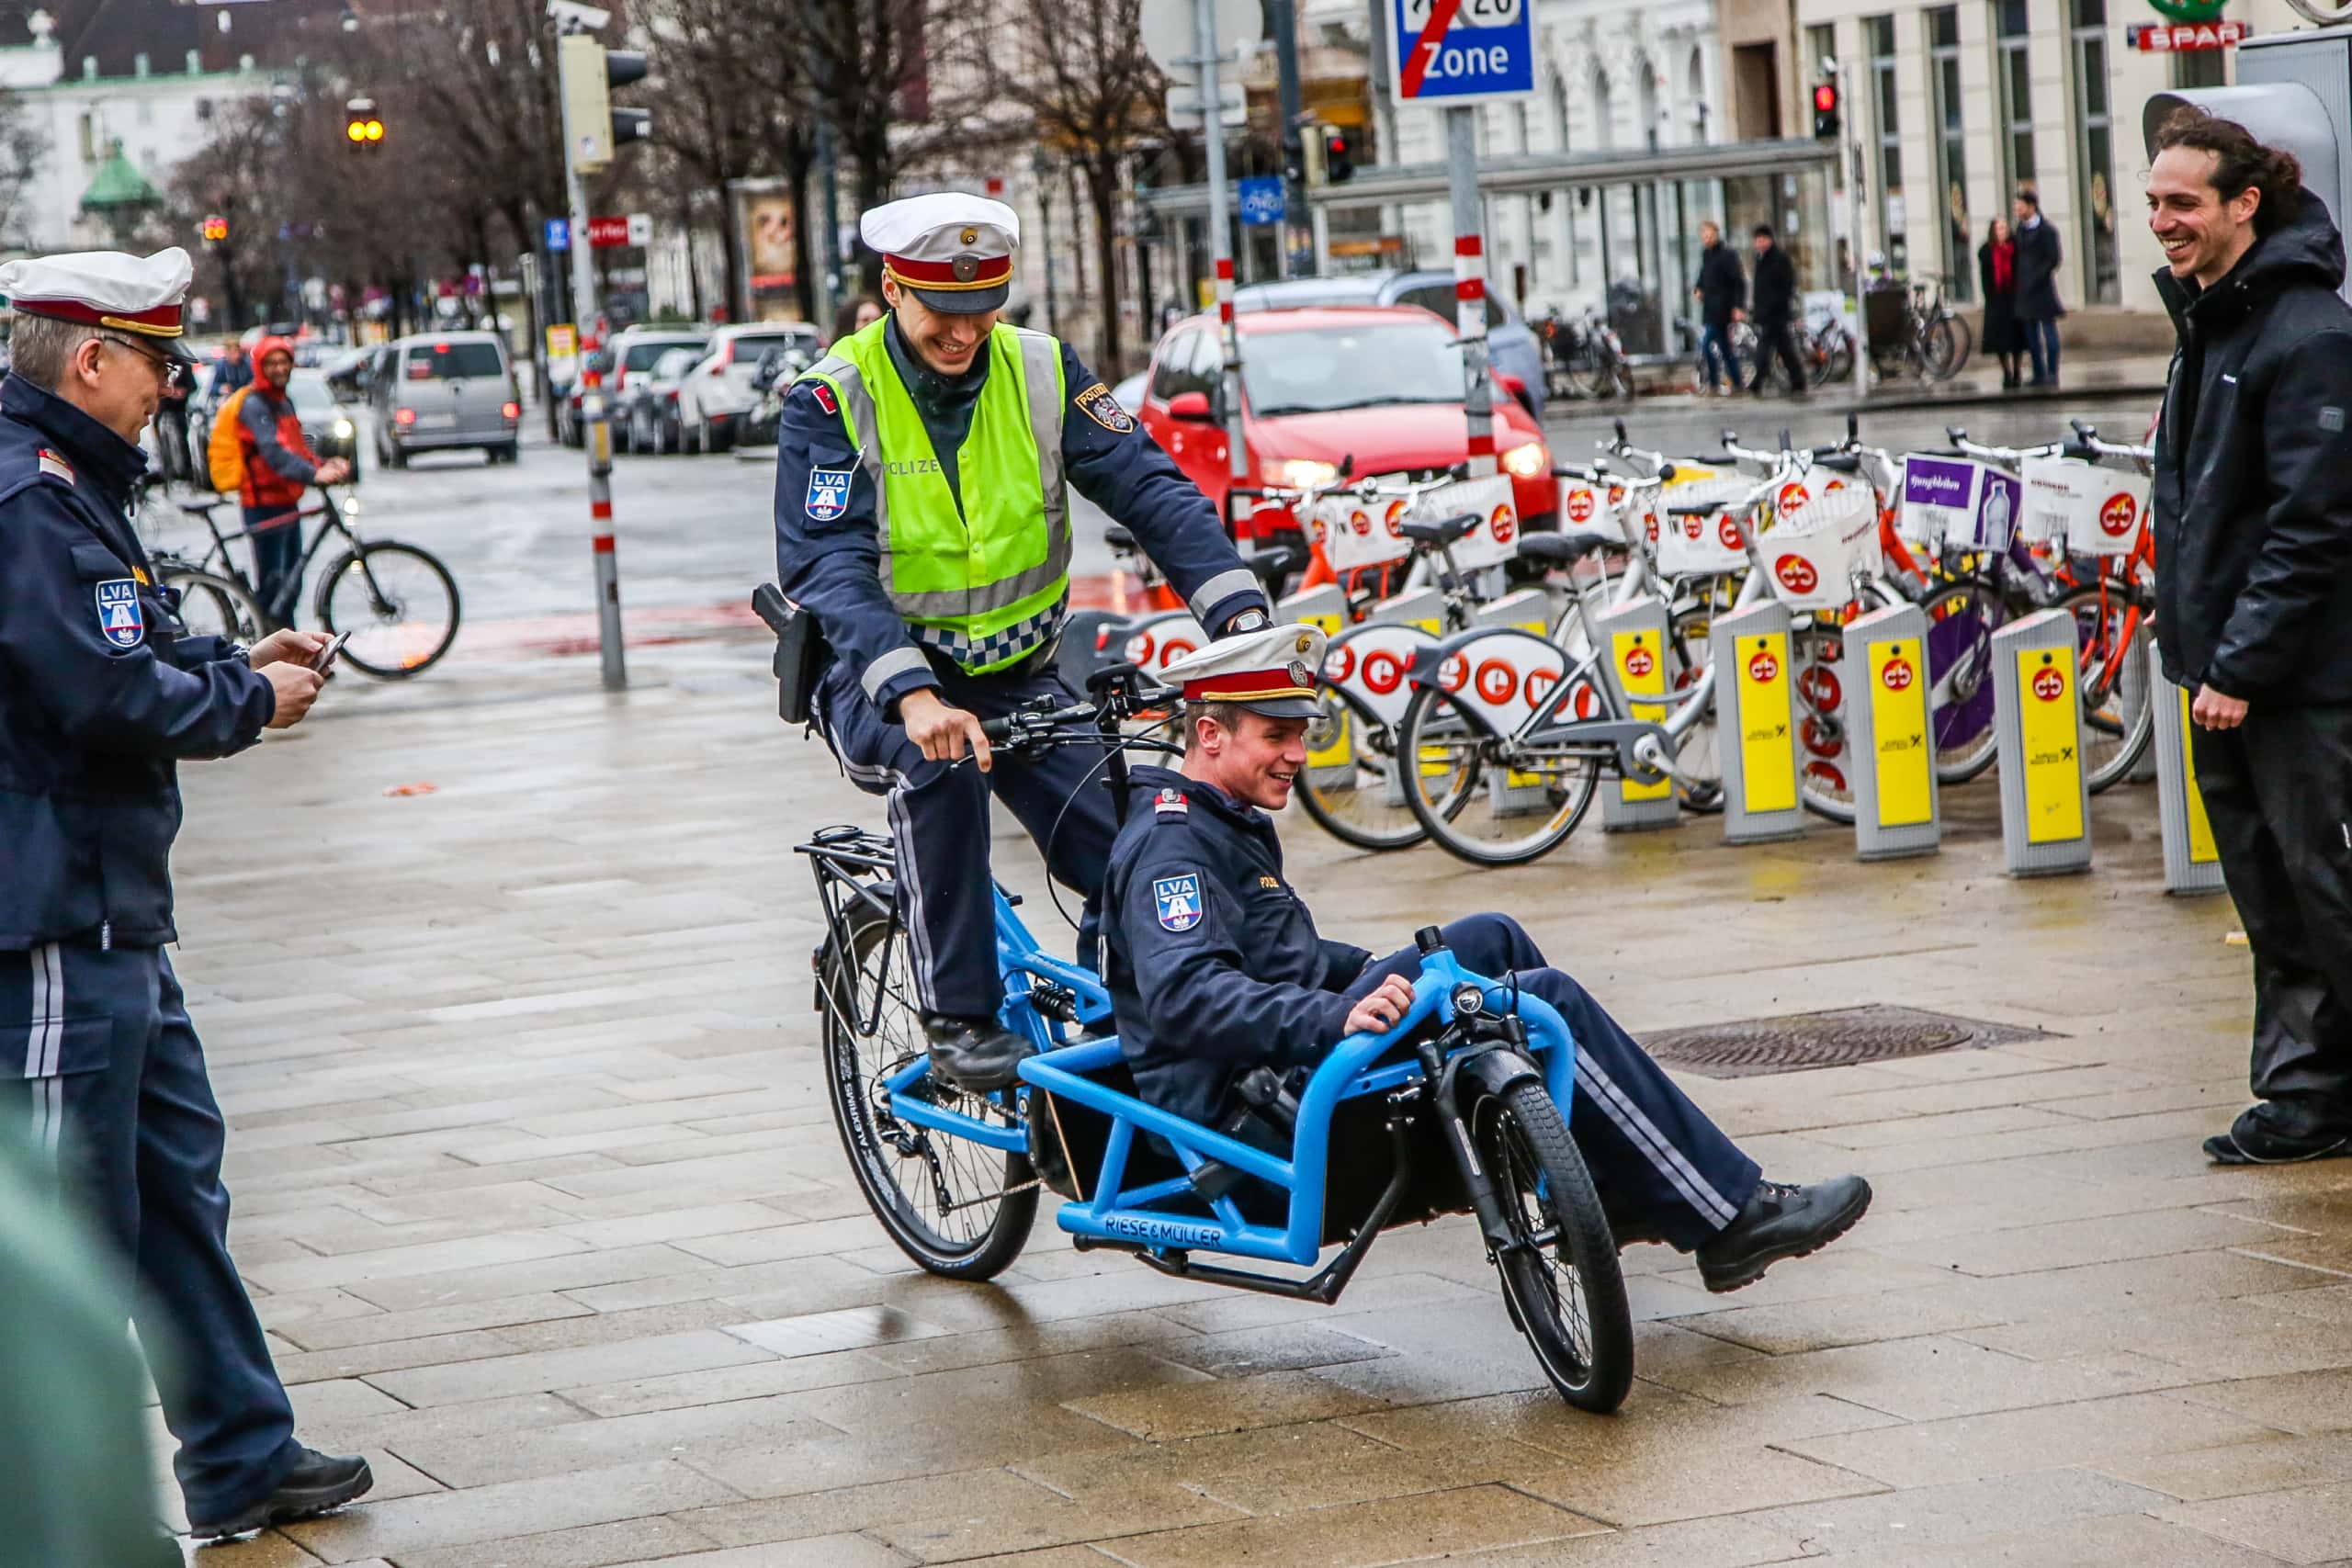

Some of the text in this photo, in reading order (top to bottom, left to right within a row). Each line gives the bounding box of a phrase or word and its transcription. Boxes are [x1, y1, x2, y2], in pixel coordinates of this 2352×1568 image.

[2150, 23, 2240, 49] SPAR
[1422, 41, 1510, 79] Zone
[814, 474, 846, 487] LVA
[100, 584, 133, 601] LVA
[1159, 879, 1194, 897] LVA
